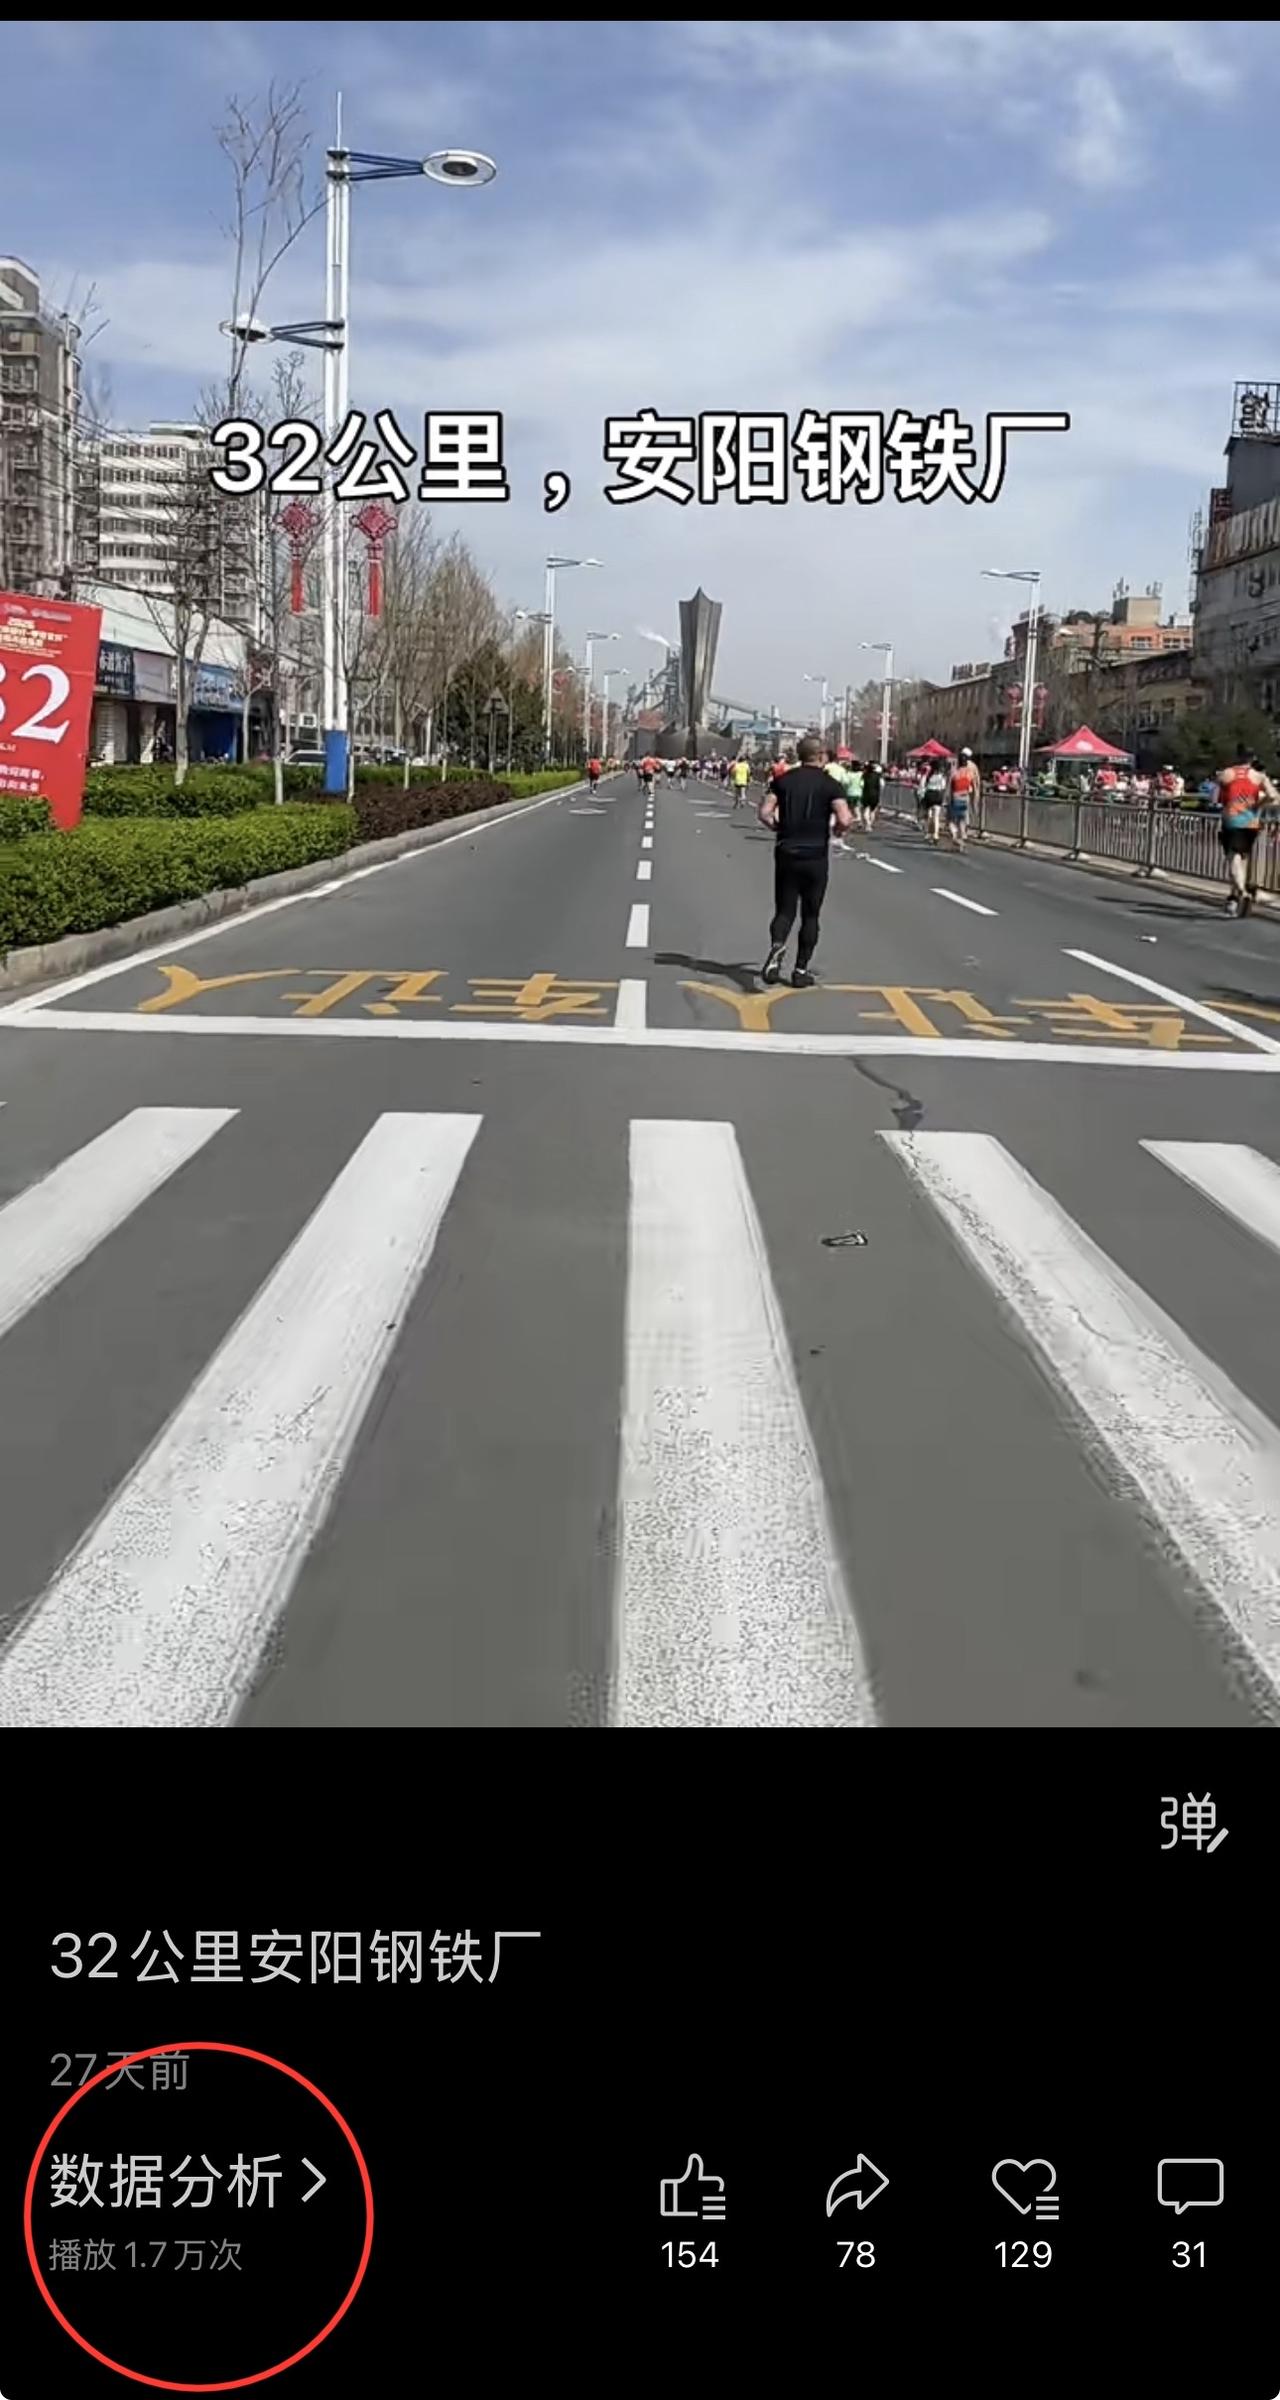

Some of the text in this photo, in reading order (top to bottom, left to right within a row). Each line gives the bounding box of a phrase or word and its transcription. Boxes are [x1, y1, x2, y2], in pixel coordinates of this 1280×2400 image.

[0, 661, 70, 744] 2
[136, 966, 620, 1020] 车让人
[677, 980, 1233, 1049] 车让人
